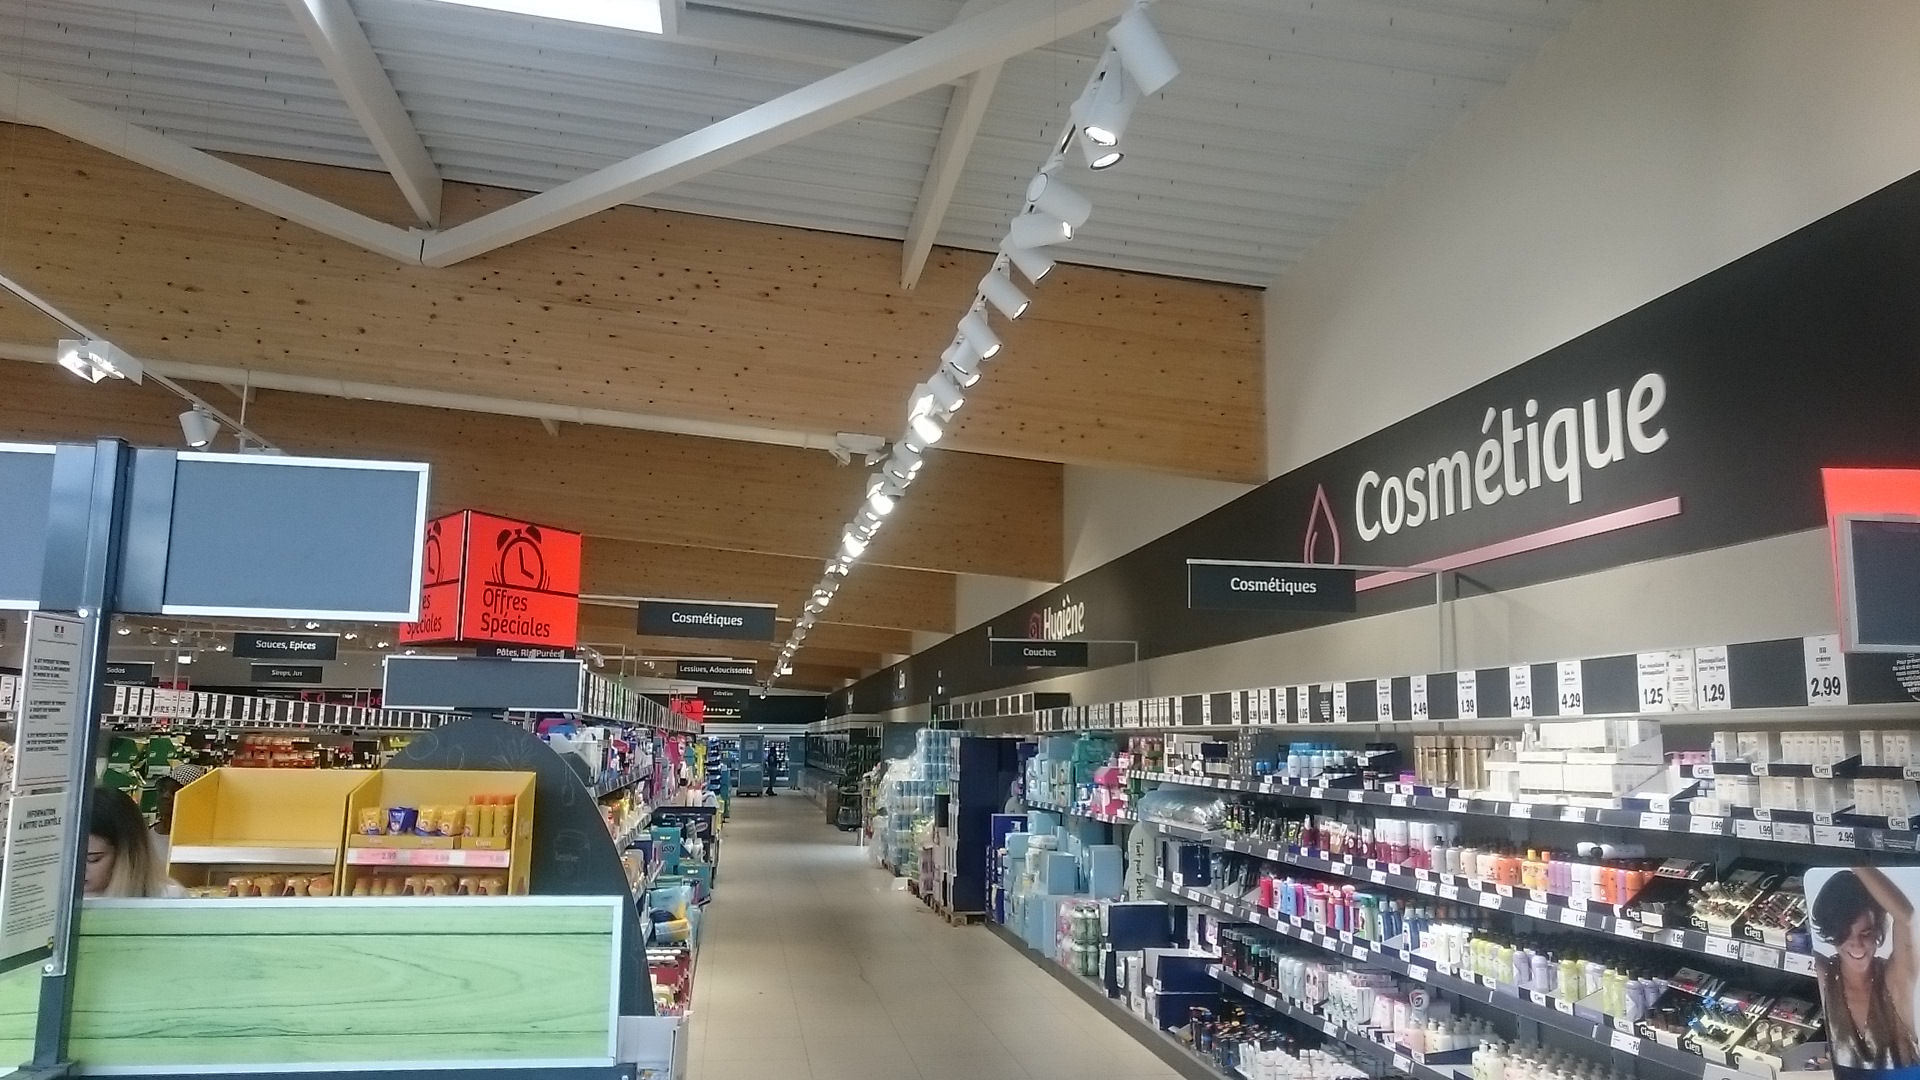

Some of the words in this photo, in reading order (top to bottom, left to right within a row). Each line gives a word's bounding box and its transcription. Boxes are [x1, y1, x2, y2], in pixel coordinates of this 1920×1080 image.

[1355, 373, 1669, 542] Cosmétique
[1230, 576, 1318, 596] Cosmétiques
[482, 587, 528, 615] Offres
[480, 612, 551, 638] Spéciales
[671, 611, 744, 628] Cosmétiques
[255, 639, 288, 650] Sauces,
[289, 640, 317, 651] Epices
[1022, 647, 1057, 657] Couches
[496, 647, 520, 658] Pâtes,
[1703, 683, 1726, 703] 1.29
[1810, 675, 1841, 698] 2.99
[1512, 695, 1531, 711] 4.29
[1561, 692, 1581, 709] 4.29
[1643, 687, 1664, 705] 1.25
[1413, 702, 1427, 716] 2.49
[1460, 699, 1475, 713] 1.39
[1815, 766, 1829, 775] Cien
[1711, 821, 1723, 831] 1.99
[1759, 825, 1771, 835] 1.99
[1891, 818, 1906, 828] Cien
[1838, 832, 1854, 843] 2.99
[1626, 908, 1641, 921] Cien
[1691, 917, 1707, 930] Cien
[1744, 926, 1763, 941] Cien
[1726, 943, 1739, 955] 1.99
[1640, 1026, 1656, 1040] Cien
[1684, 1039, 1701, 1054] Cien
